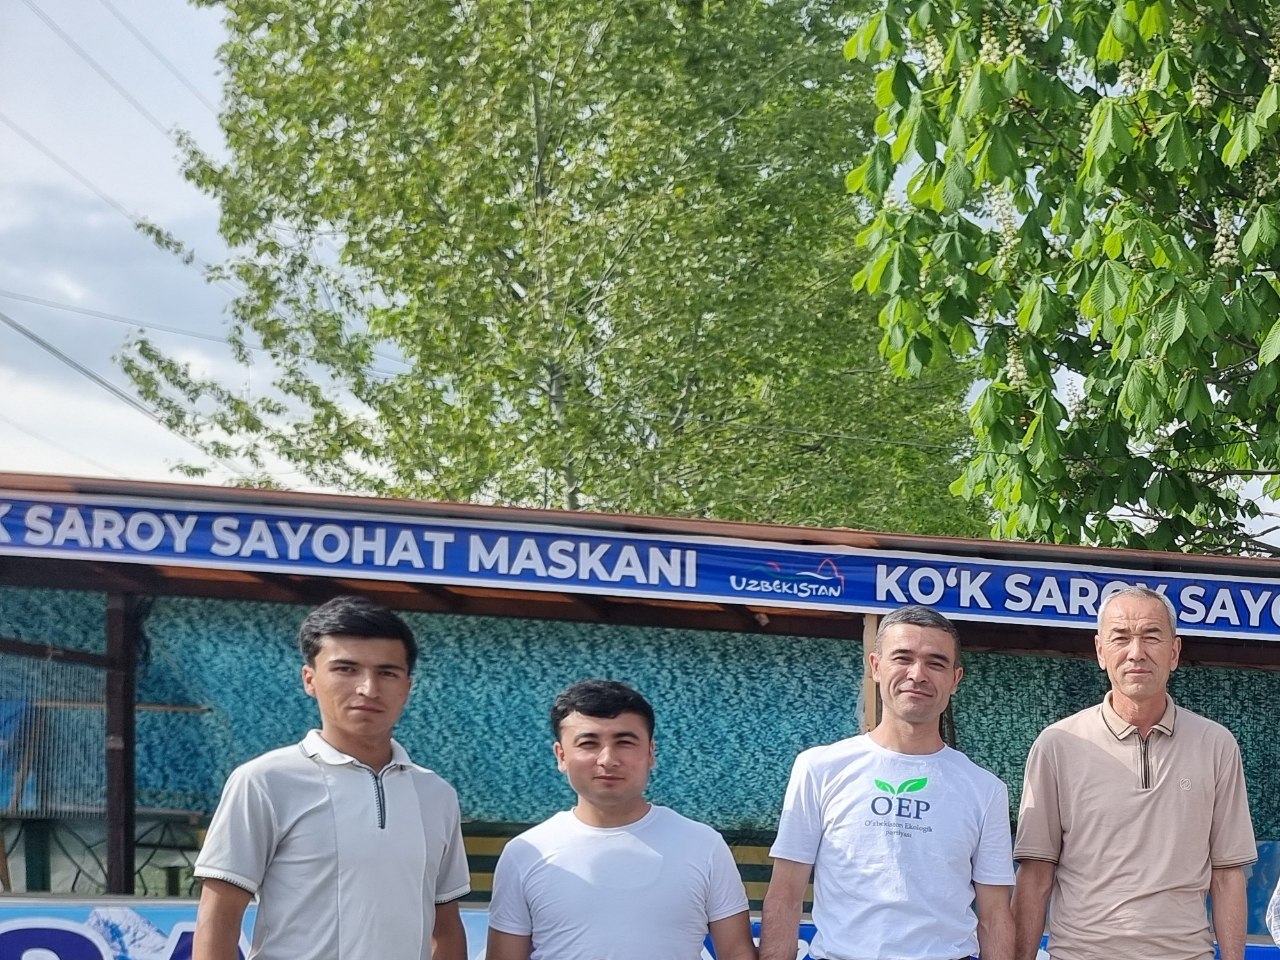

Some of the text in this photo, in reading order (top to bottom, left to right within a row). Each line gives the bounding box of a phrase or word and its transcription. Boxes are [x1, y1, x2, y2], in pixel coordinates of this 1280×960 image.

[24, 504, 198, 553] SAROY
[210, 518, 454, 570] SAYOHAT
[468, 535, 697, 588] MASKANI
[729, 575, 842, 598] UZBEKISTAN
[1004, 574, 1168, 614] SAR
